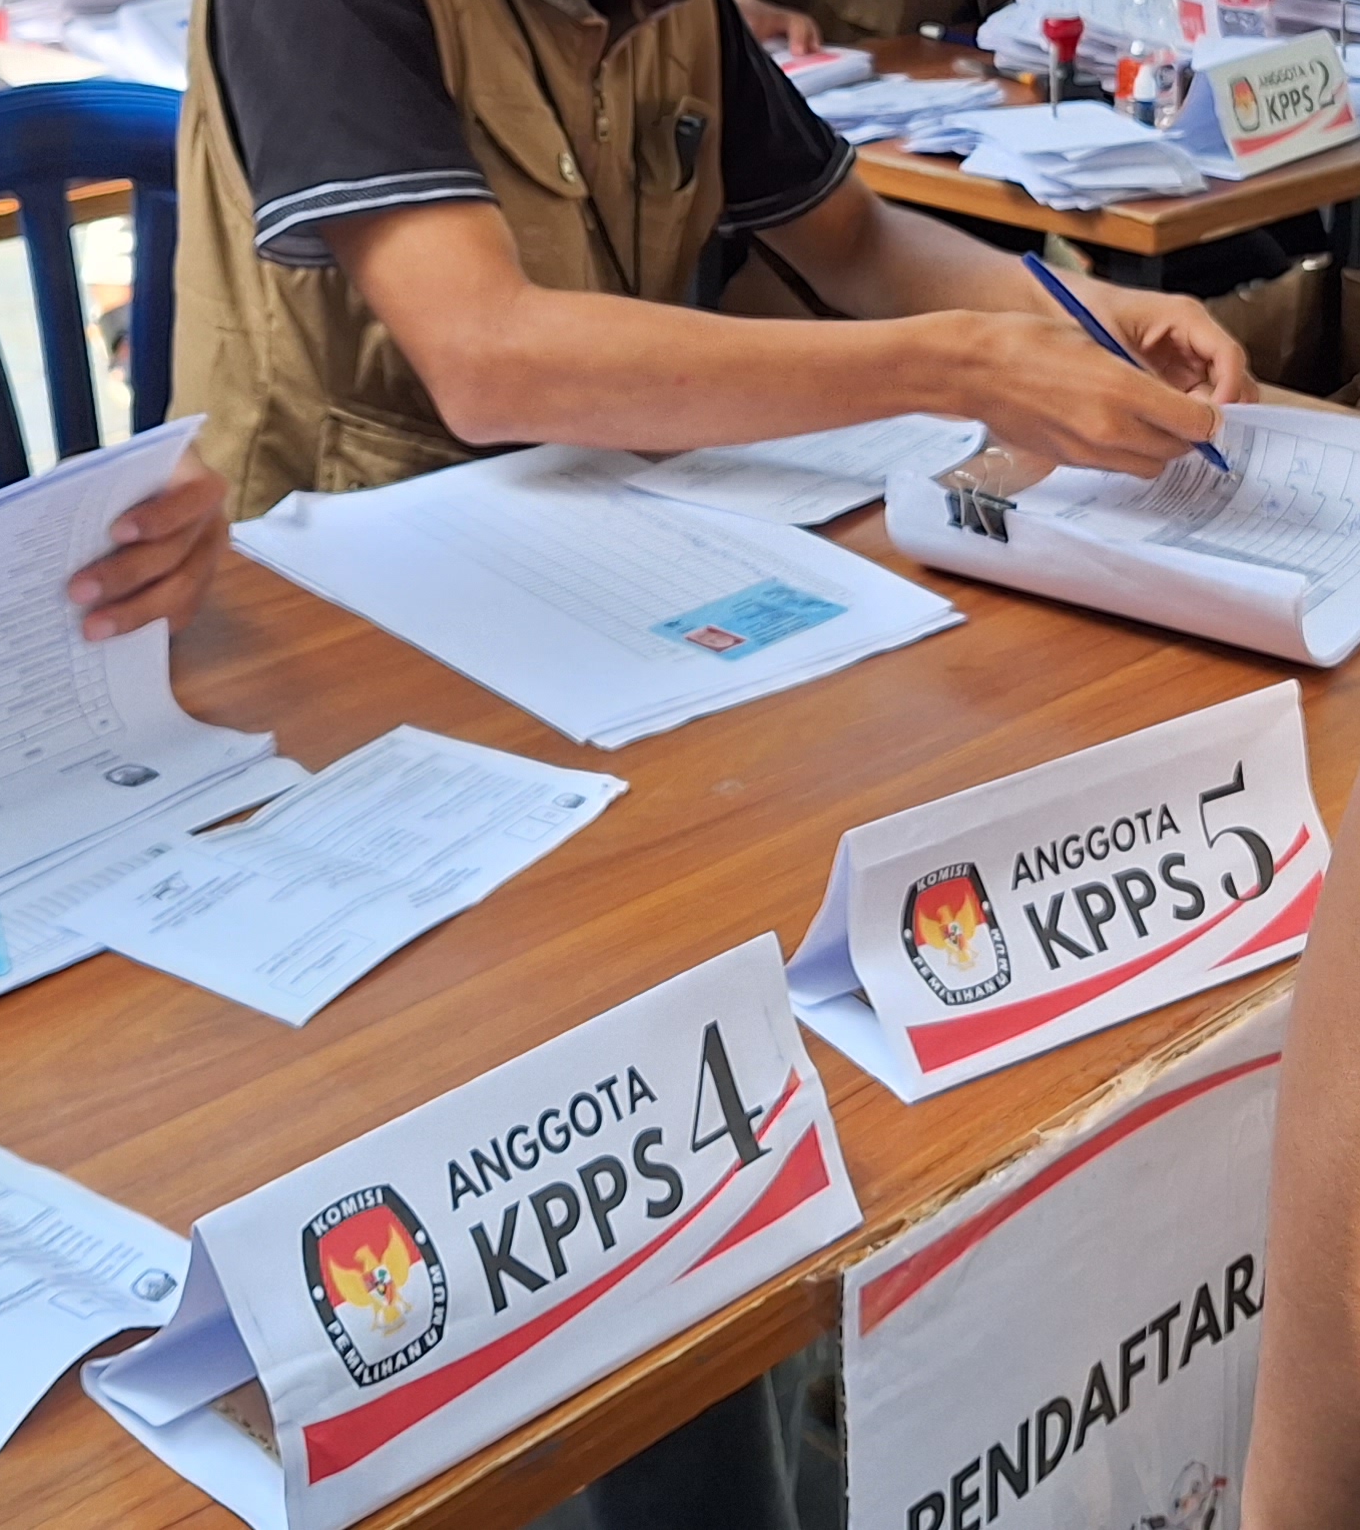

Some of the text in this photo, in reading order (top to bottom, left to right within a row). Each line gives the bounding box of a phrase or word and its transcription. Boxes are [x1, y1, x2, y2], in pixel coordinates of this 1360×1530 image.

[1265, 59, 1336, 124] KPPS 2
[915, 863, 971, 894] KOMISI
[1010, 802, 1181, 891] ANGGOTA
[1023, 760, 1275, 971] KPPS 5
[913, 956, 997, 1005] PEMILIHAN
[448, 1064, 657, 1211] ANGGOTA
[468, 1019, 772, 1315] KPPS 4
[311, 1186, 385, 1238] KOMISI
[327, 1265, 446, 1387] PEMILIHAN UMUM
[906, 1253, 1264, 1530] PENDAFTAR
